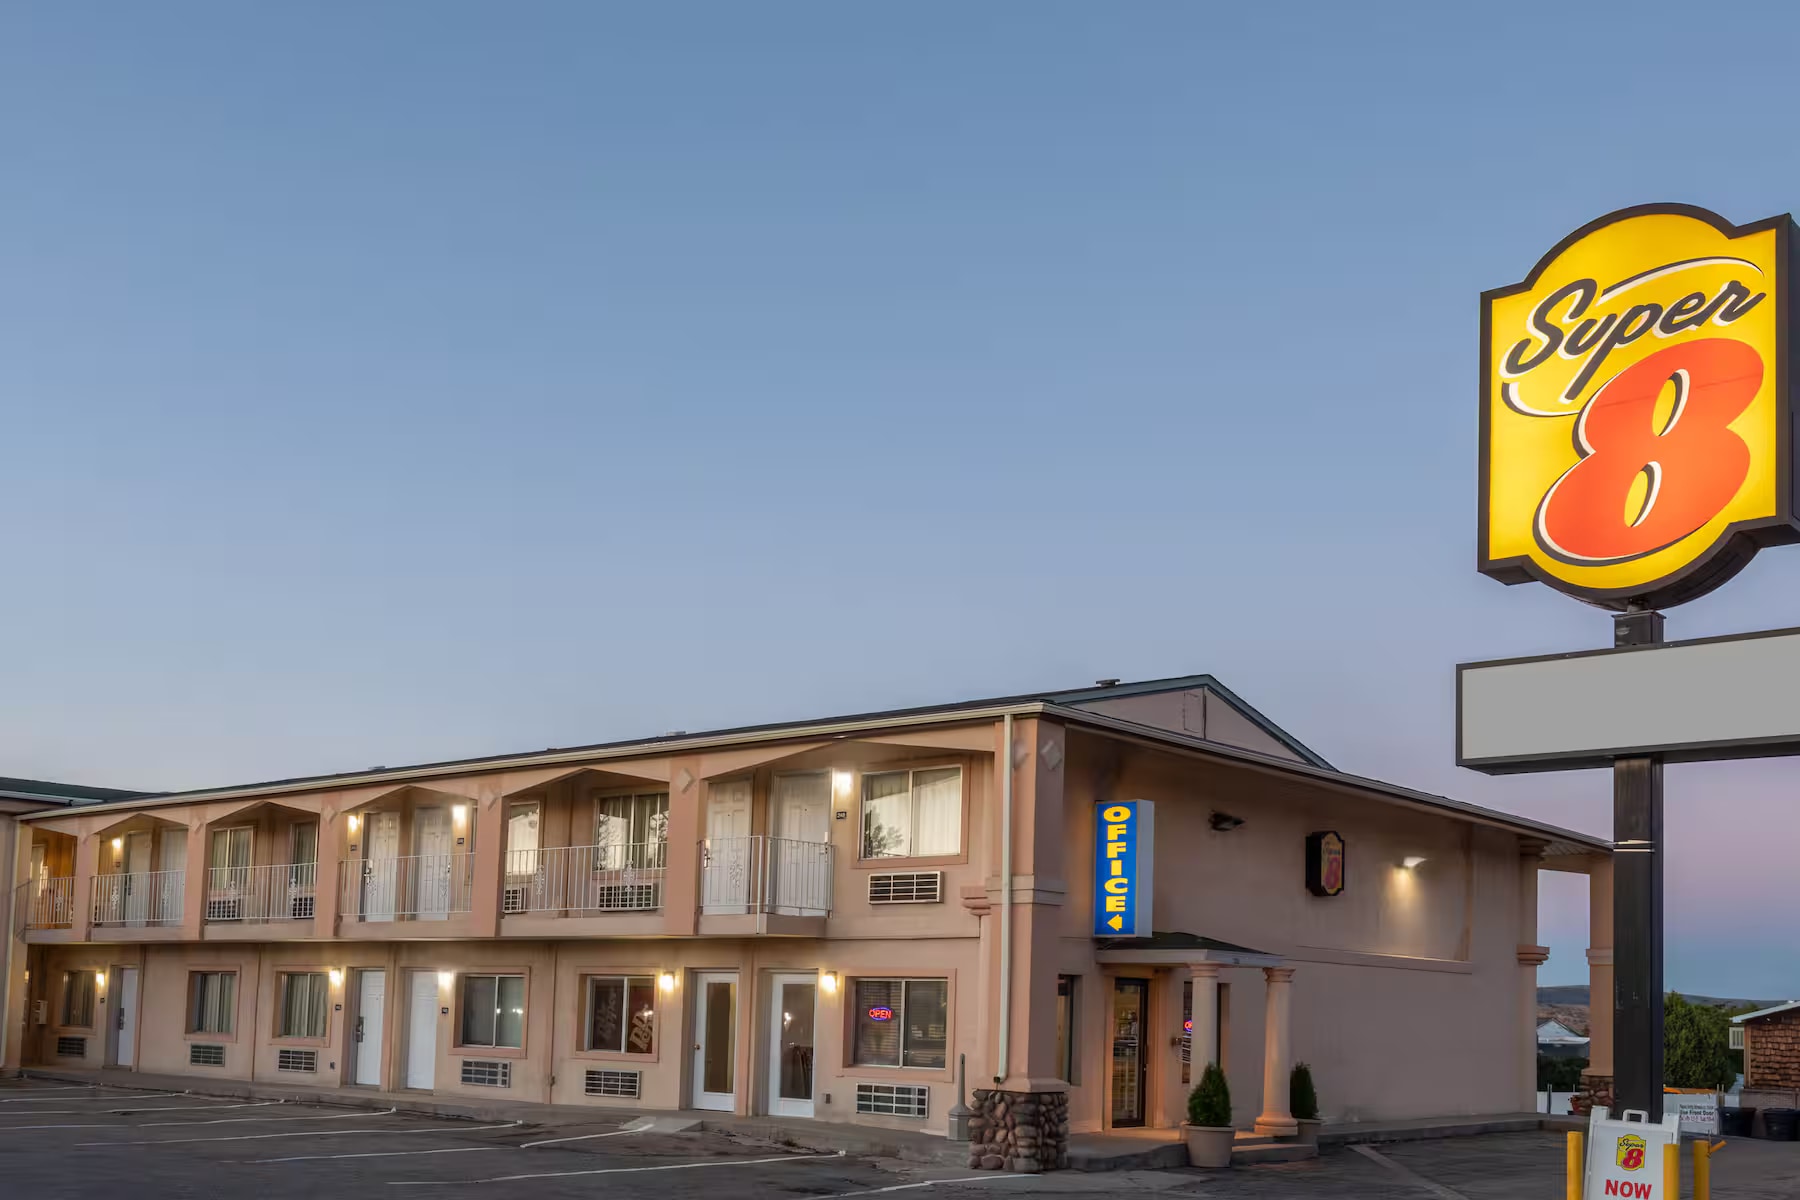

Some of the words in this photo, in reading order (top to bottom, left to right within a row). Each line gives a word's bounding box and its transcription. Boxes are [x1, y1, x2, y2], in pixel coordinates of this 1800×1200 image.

[1500, 277, 1767, 404] Super
[1532, 337, 1765, 567] 8
[1103, 805, 1131, 912] OFFICE
[868, 1008, 892, 1019] OPEN
[1605, 1179, 1652, 1200] NOW
[1622, 1148, 1644, 1169] 8
